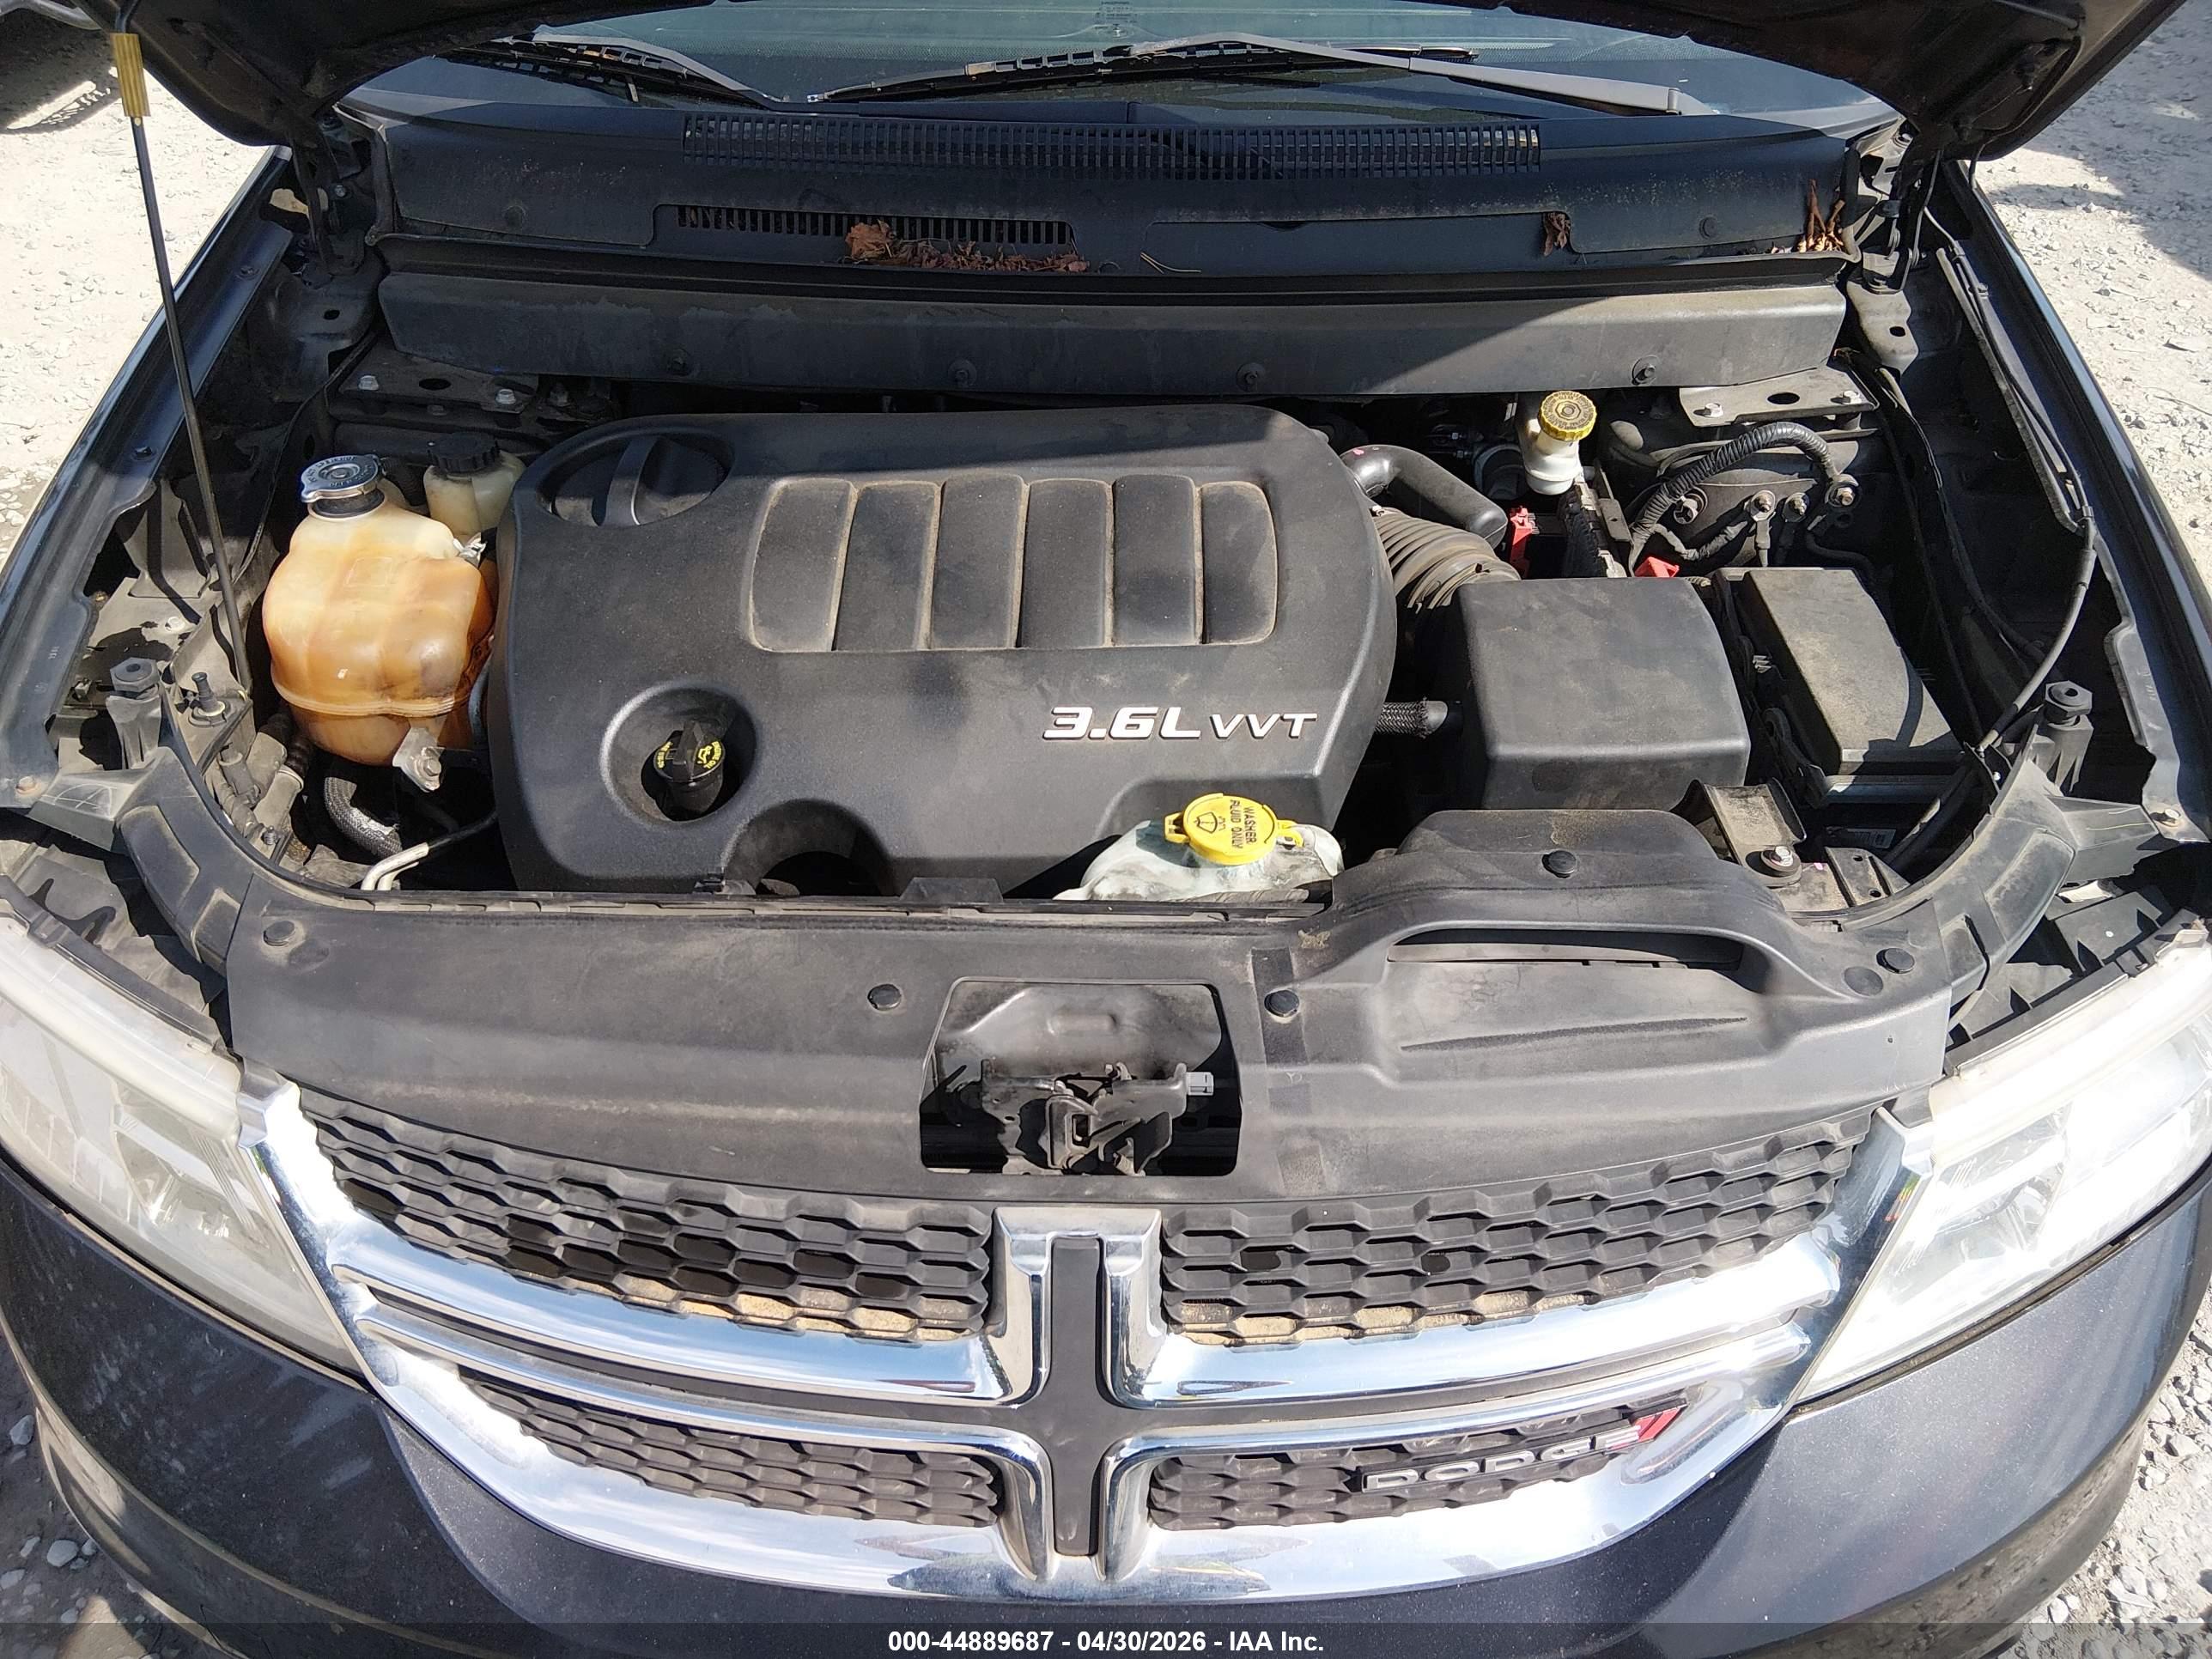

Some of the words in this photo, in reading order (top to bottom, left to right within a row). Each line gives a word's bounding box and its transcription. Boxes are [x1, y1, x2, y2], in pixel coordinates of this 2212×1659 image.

[1042, 706, 1201, 740] 3.6L
[1209, 712, 1318, 739] VVT
[1230, 799, 1242, 823] FLUID
[1243, 806, 1257, 845] WASHER
[1231, 827, 1243, 849] ONLY
[1363, 1425, 1641, 1492] DODGE
